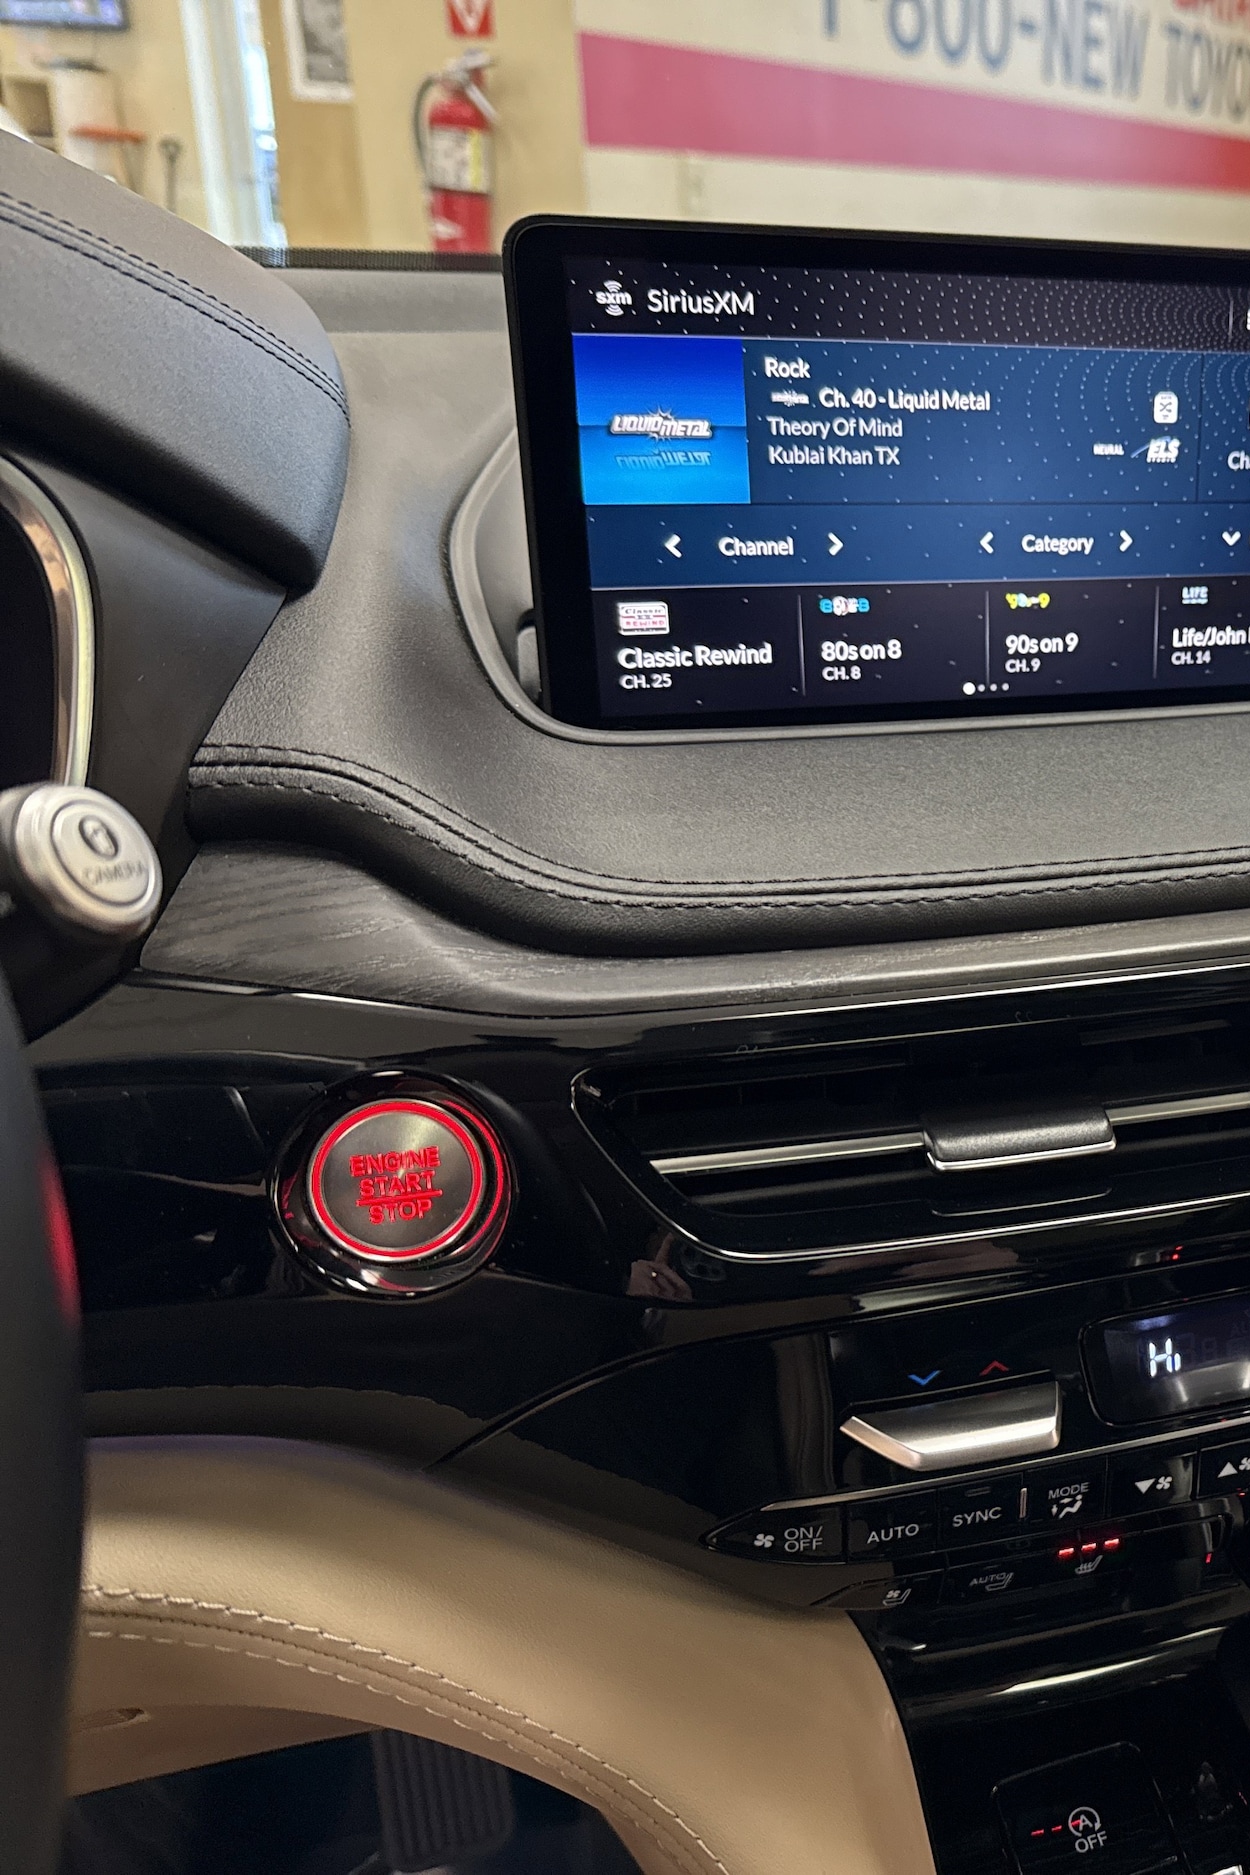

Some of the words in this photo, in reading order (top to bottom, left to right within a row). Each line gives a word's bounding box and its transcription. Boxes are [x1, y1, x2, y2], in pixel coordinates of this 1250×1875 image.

[818, 0, 1152, 103] 800-NEW
[647, 289, 755, 317] SiriusXM
[763, 356, 811, 379] Rock
[818, 386, 850, 409] Ch.
[852, 387, 876, 409] 40
[888, 388, 939, 413] Liquid
[942, 390, 991, 412] Metal
[766, 415, 830, 440] Theory
[832, 416, 857, 436] Of
[859, 416, 903, 438] Mind
[767, 445, 825, 465] Kublai
[828, 445, 873, 465] Khan
[875, 445, 901, 465] TX
[717, 535, 795, 558] Channel
[1021, 533, 1094, 556] Category
[1005, 634, 1039, 655] 90s
[1039, 637, 1063, 652] on
[1065, 632, 1079, 652] 9
[1172, 624, 1247, 648] Life/John
[617, 645, 693, 670] Classic
[695, 641, 773, 667] Rewind
[821, 640, 859, 663] 80s
[859, 644, 886, 661] on
[887, 638, 903, 660] 8
[1171, 650, 1194, 666] CH.
[1195, 650, 1212, 665] 14
[822, 666, 850, 682] CH.
[850, 666, 862, 680] 8
[1004, 658, 1029, 673] CH.
[1030, 657, 1041, 673] 9
[619, 674, 650, 690] CH.
[651, 672, 673, 689] 25
[349, 1145, 441, 1177] ENGINE
[359, 1170, 436, 1198] START
[369, 1199, 433, 1225] STOP
[1048, 1481, 1089, 1501] MODE
[952, 1506, 1003, 1528] SYNC
[783, 1525, 824, 1541] ON/
[867, 1523, 919, 1545] AUTO
[784, 1537, 824, 1553] OFF
[968, 1572, 1007, 1587] AUTO
[1075, 1830, 1108, 1854] OFF
